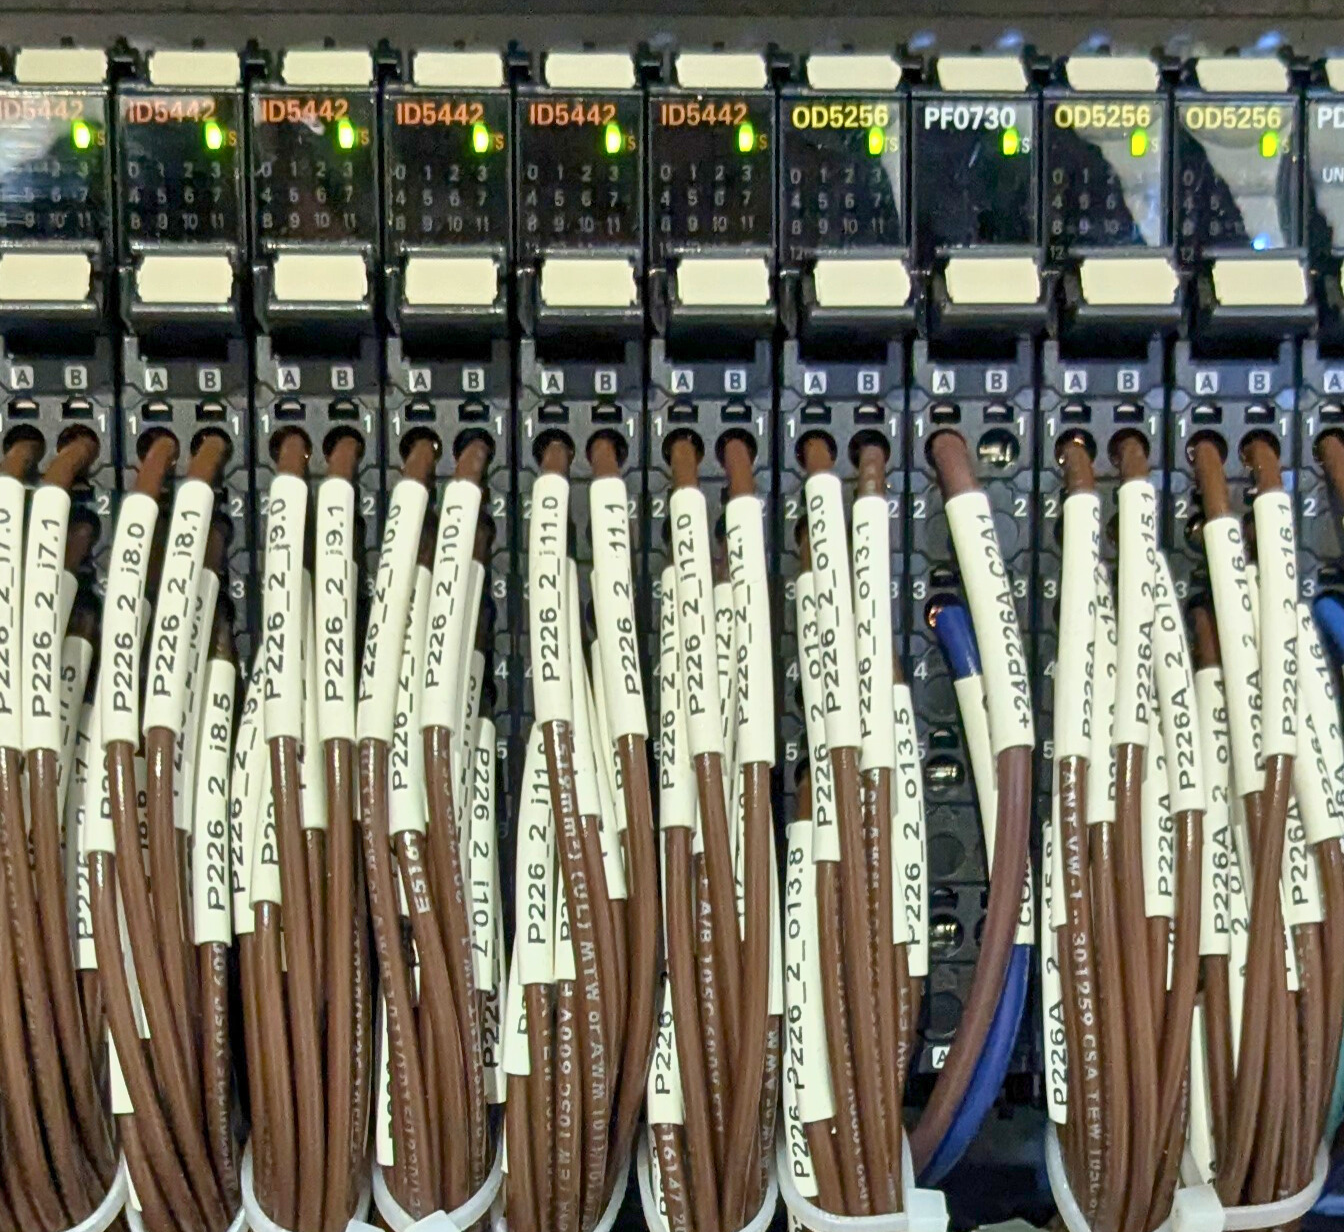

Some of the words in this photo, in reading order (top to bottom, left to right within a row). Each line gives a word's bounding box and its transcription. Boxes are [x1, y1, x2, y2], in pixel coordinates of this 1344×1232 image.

[127, 99, 216, 123] ID5442
[261, 99, 349, 123] ID5442
[396, 101, 484, 126] ID5442
[529, 102, 617, 127] ID5442
[661, 102, 748, 127] ID5442
[791, 105, 889, 129] OD5256
[924, 106, 1016, 130] PF0730
[1054, 105, 1151, 129] OD5256
[1185, 105, 1282, 129] OD5256
[31, 518, 61, 718] P226_2_i7.1
[113, 522, 144, 713] P226_2_i8.0
[151, 509, 200, 697] P226_2_i8.1
[324, 504, 349, 702] P226_2_i9.1
[425, 503, 463, 689] P226_2_i10.1
[538, 496, 560, 682] P226_2_i11.0
[675, 513, 706, 716] P226_2_i12.0
[807, 495, 841, 713] P226_2_o13.0
[206, 692, 230, 912] P226_2_i8.5
